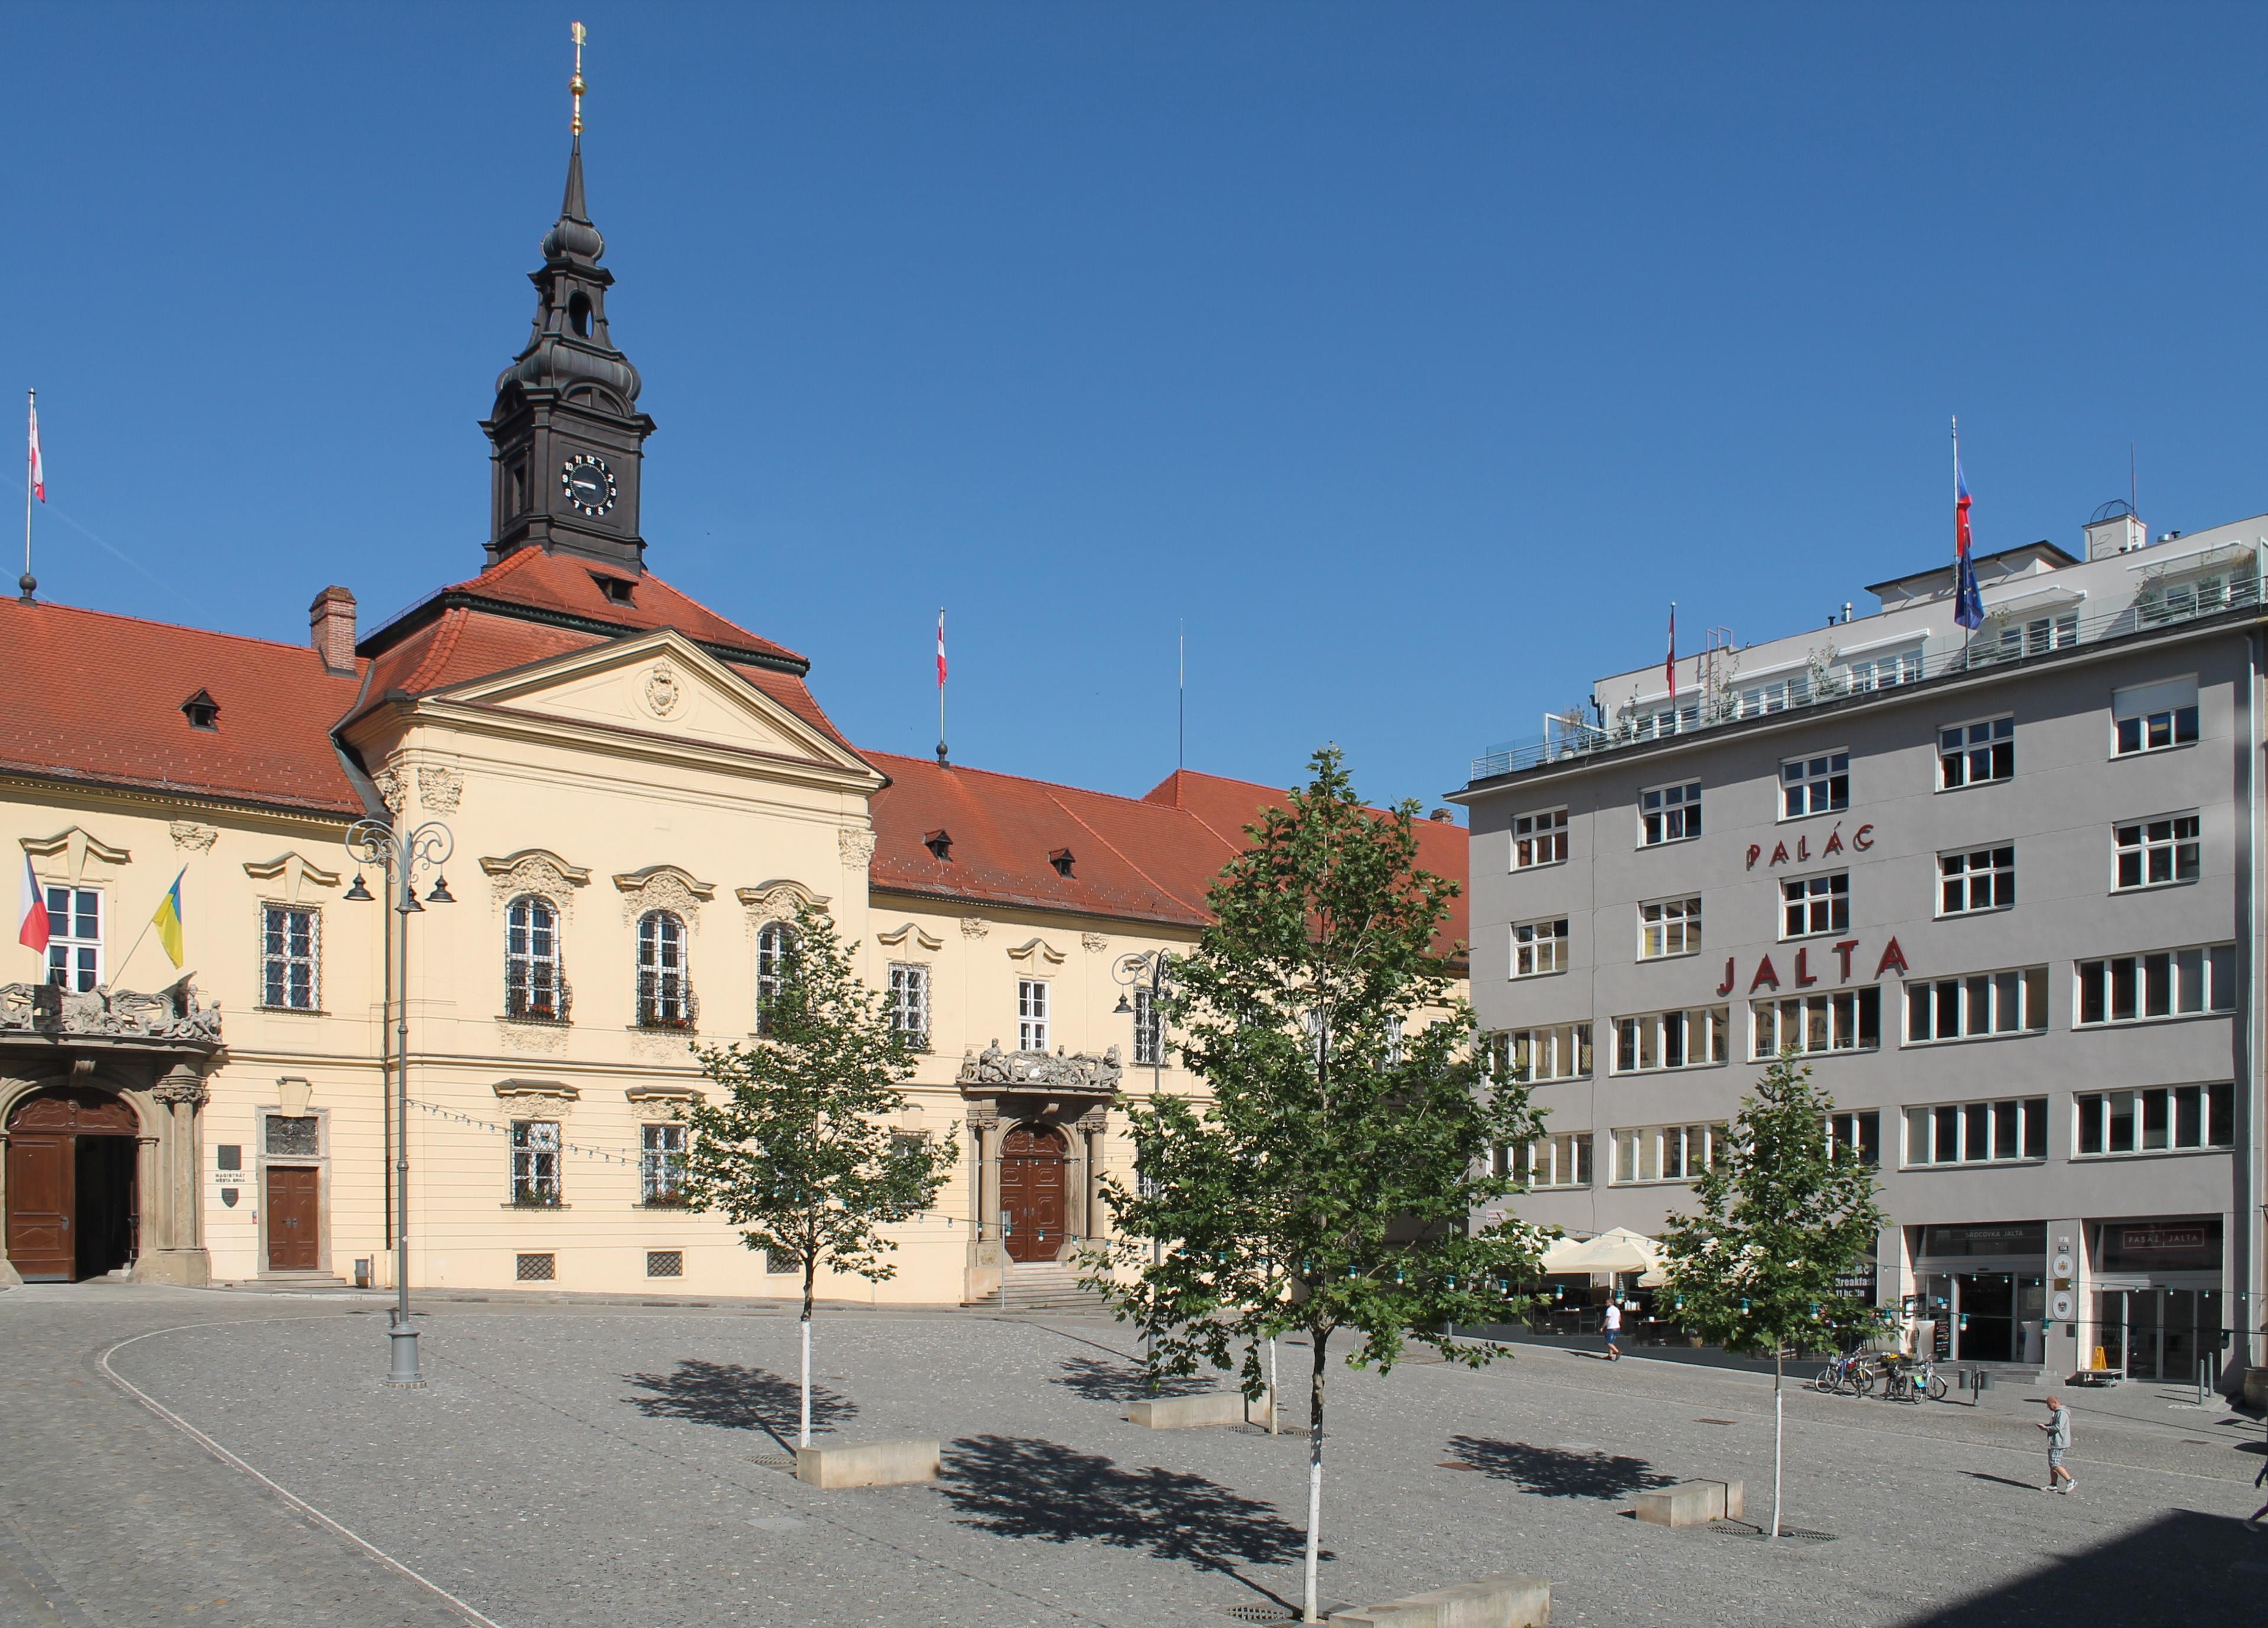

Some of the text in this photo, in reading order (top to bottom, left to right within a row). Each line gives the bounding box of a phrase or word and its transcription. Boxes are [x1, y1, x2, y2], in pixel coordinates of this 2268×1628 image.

[575, 455, 582, 464] 11
[586, 455, 595, 465] 12
[565, 462, 573, 471] 10
[599, 462, 605, 471] 1
[562, 474, 568, 483] 9
[607, 474, 614, 483] 2
[565, 488, 571, 497] 8
[610, 488, 616, 496] 3
[573, 500, 579, 508] 7
[607, 500, 614, 508] 4
[585, 507, 592, 516] 6
[598, 507, 604, 516] 5
[1749, 821, 1874, 866] PALÁC
[1719, 935, 1909, 992] JALTA
[2129, 1234, 2159, 1243] PASÁŽ
